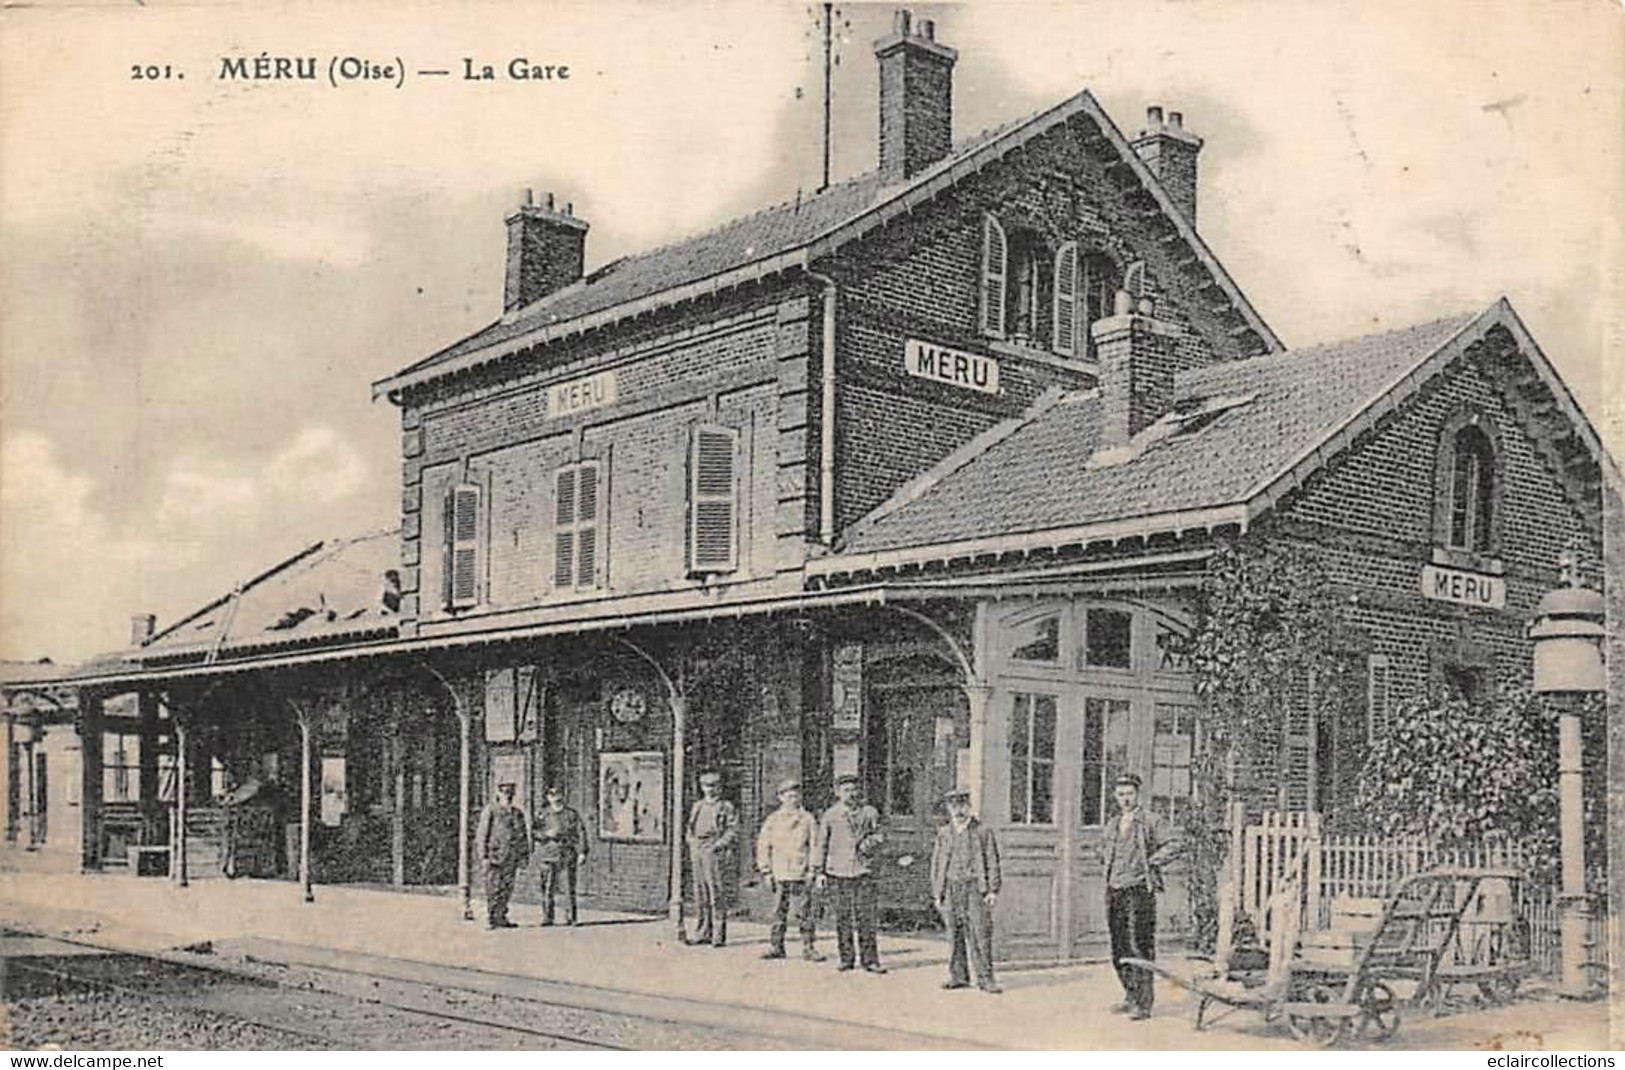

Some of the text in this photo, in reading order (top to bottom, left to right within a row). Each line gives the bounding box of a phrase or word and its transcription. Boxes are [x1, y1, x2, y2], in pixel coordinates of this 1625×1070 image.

[918, 345, 988, 387] MERU
[557, 379, 604, 413] MERU
[1434, 572, 1492, 603] MERU
